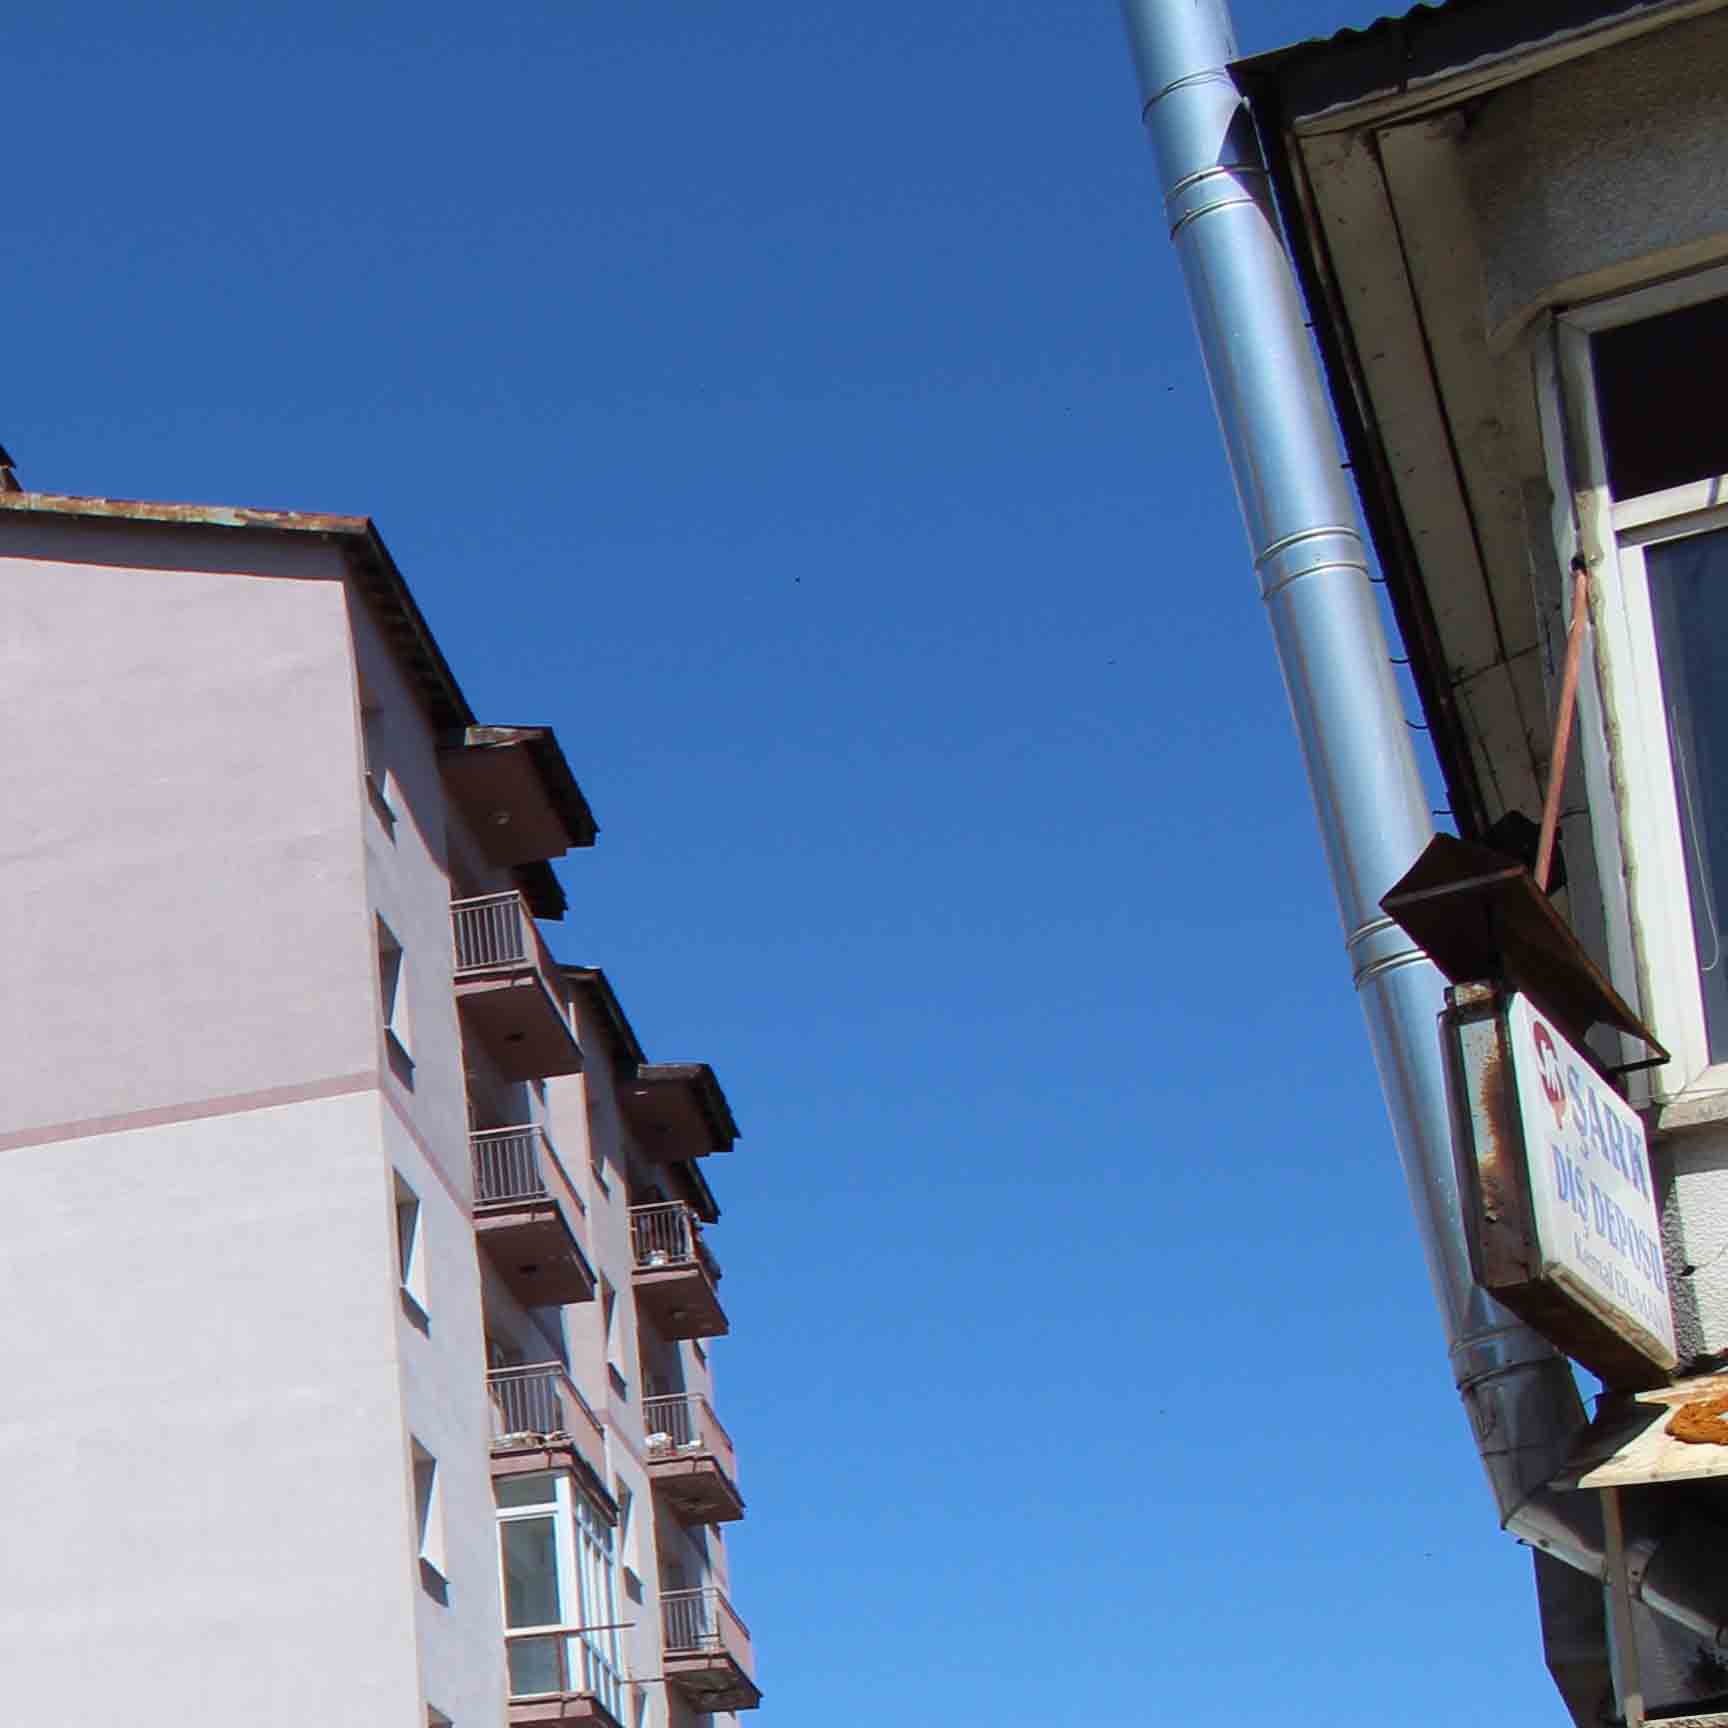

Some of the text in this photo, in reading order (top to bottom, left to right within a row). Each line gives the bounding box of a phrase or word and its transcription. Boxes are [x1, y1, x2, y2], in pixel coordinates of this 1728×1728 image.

[1567, 1065, 1649, 1202] ŞARK
[1552, 1141, 1665, 1294] DİŞ DEPOSU
